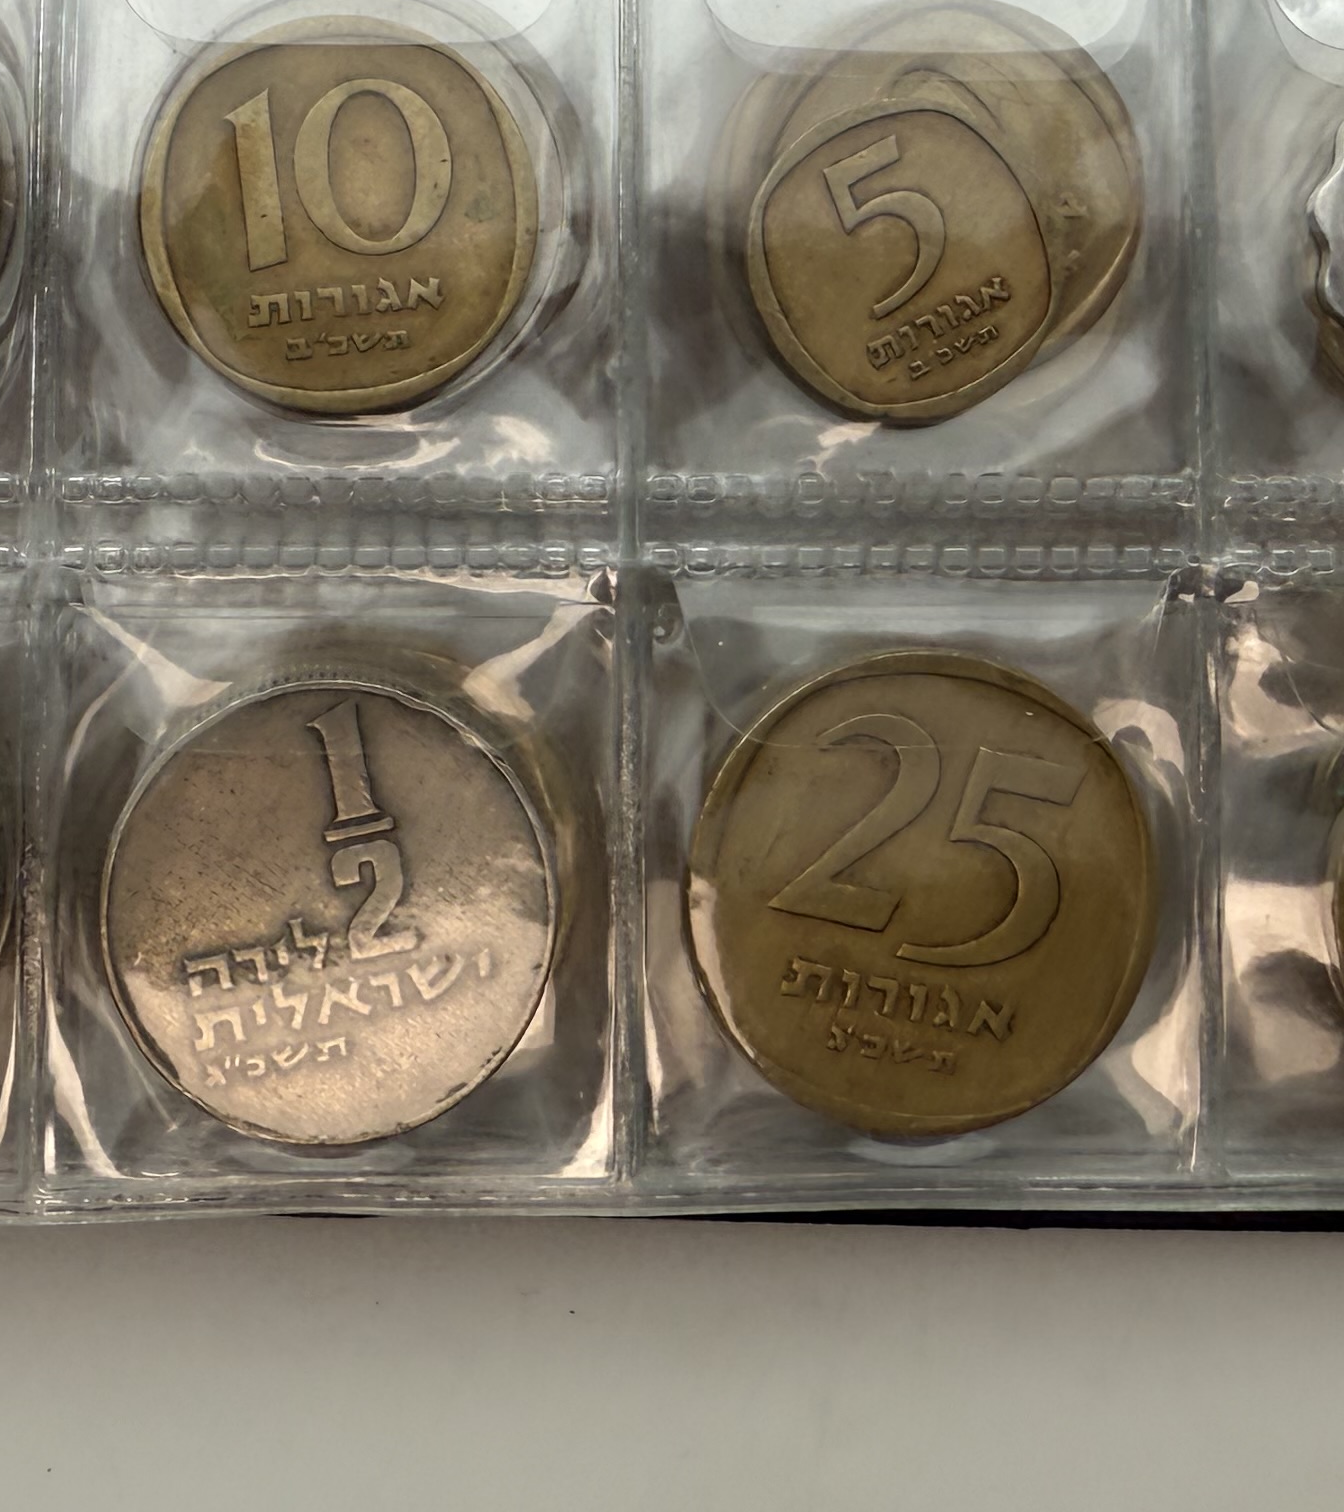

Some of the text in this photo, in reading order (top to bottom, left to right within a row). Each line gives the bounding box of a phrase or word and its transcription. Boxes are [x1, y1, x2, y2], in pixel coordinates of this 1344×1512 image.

[223, 77, 453, 272] 10
[822, 133, 947, 321] 5
[247, 276, 446, 329] אגורות
[866, 275, 1012, 370] אגורות
[766, 711, 1090, 969] 25
[183, 917, 330, 997] לירה
[194, 946, 493, 1052] ישראלית
[779, 955, 1017, 1043] אגורות
